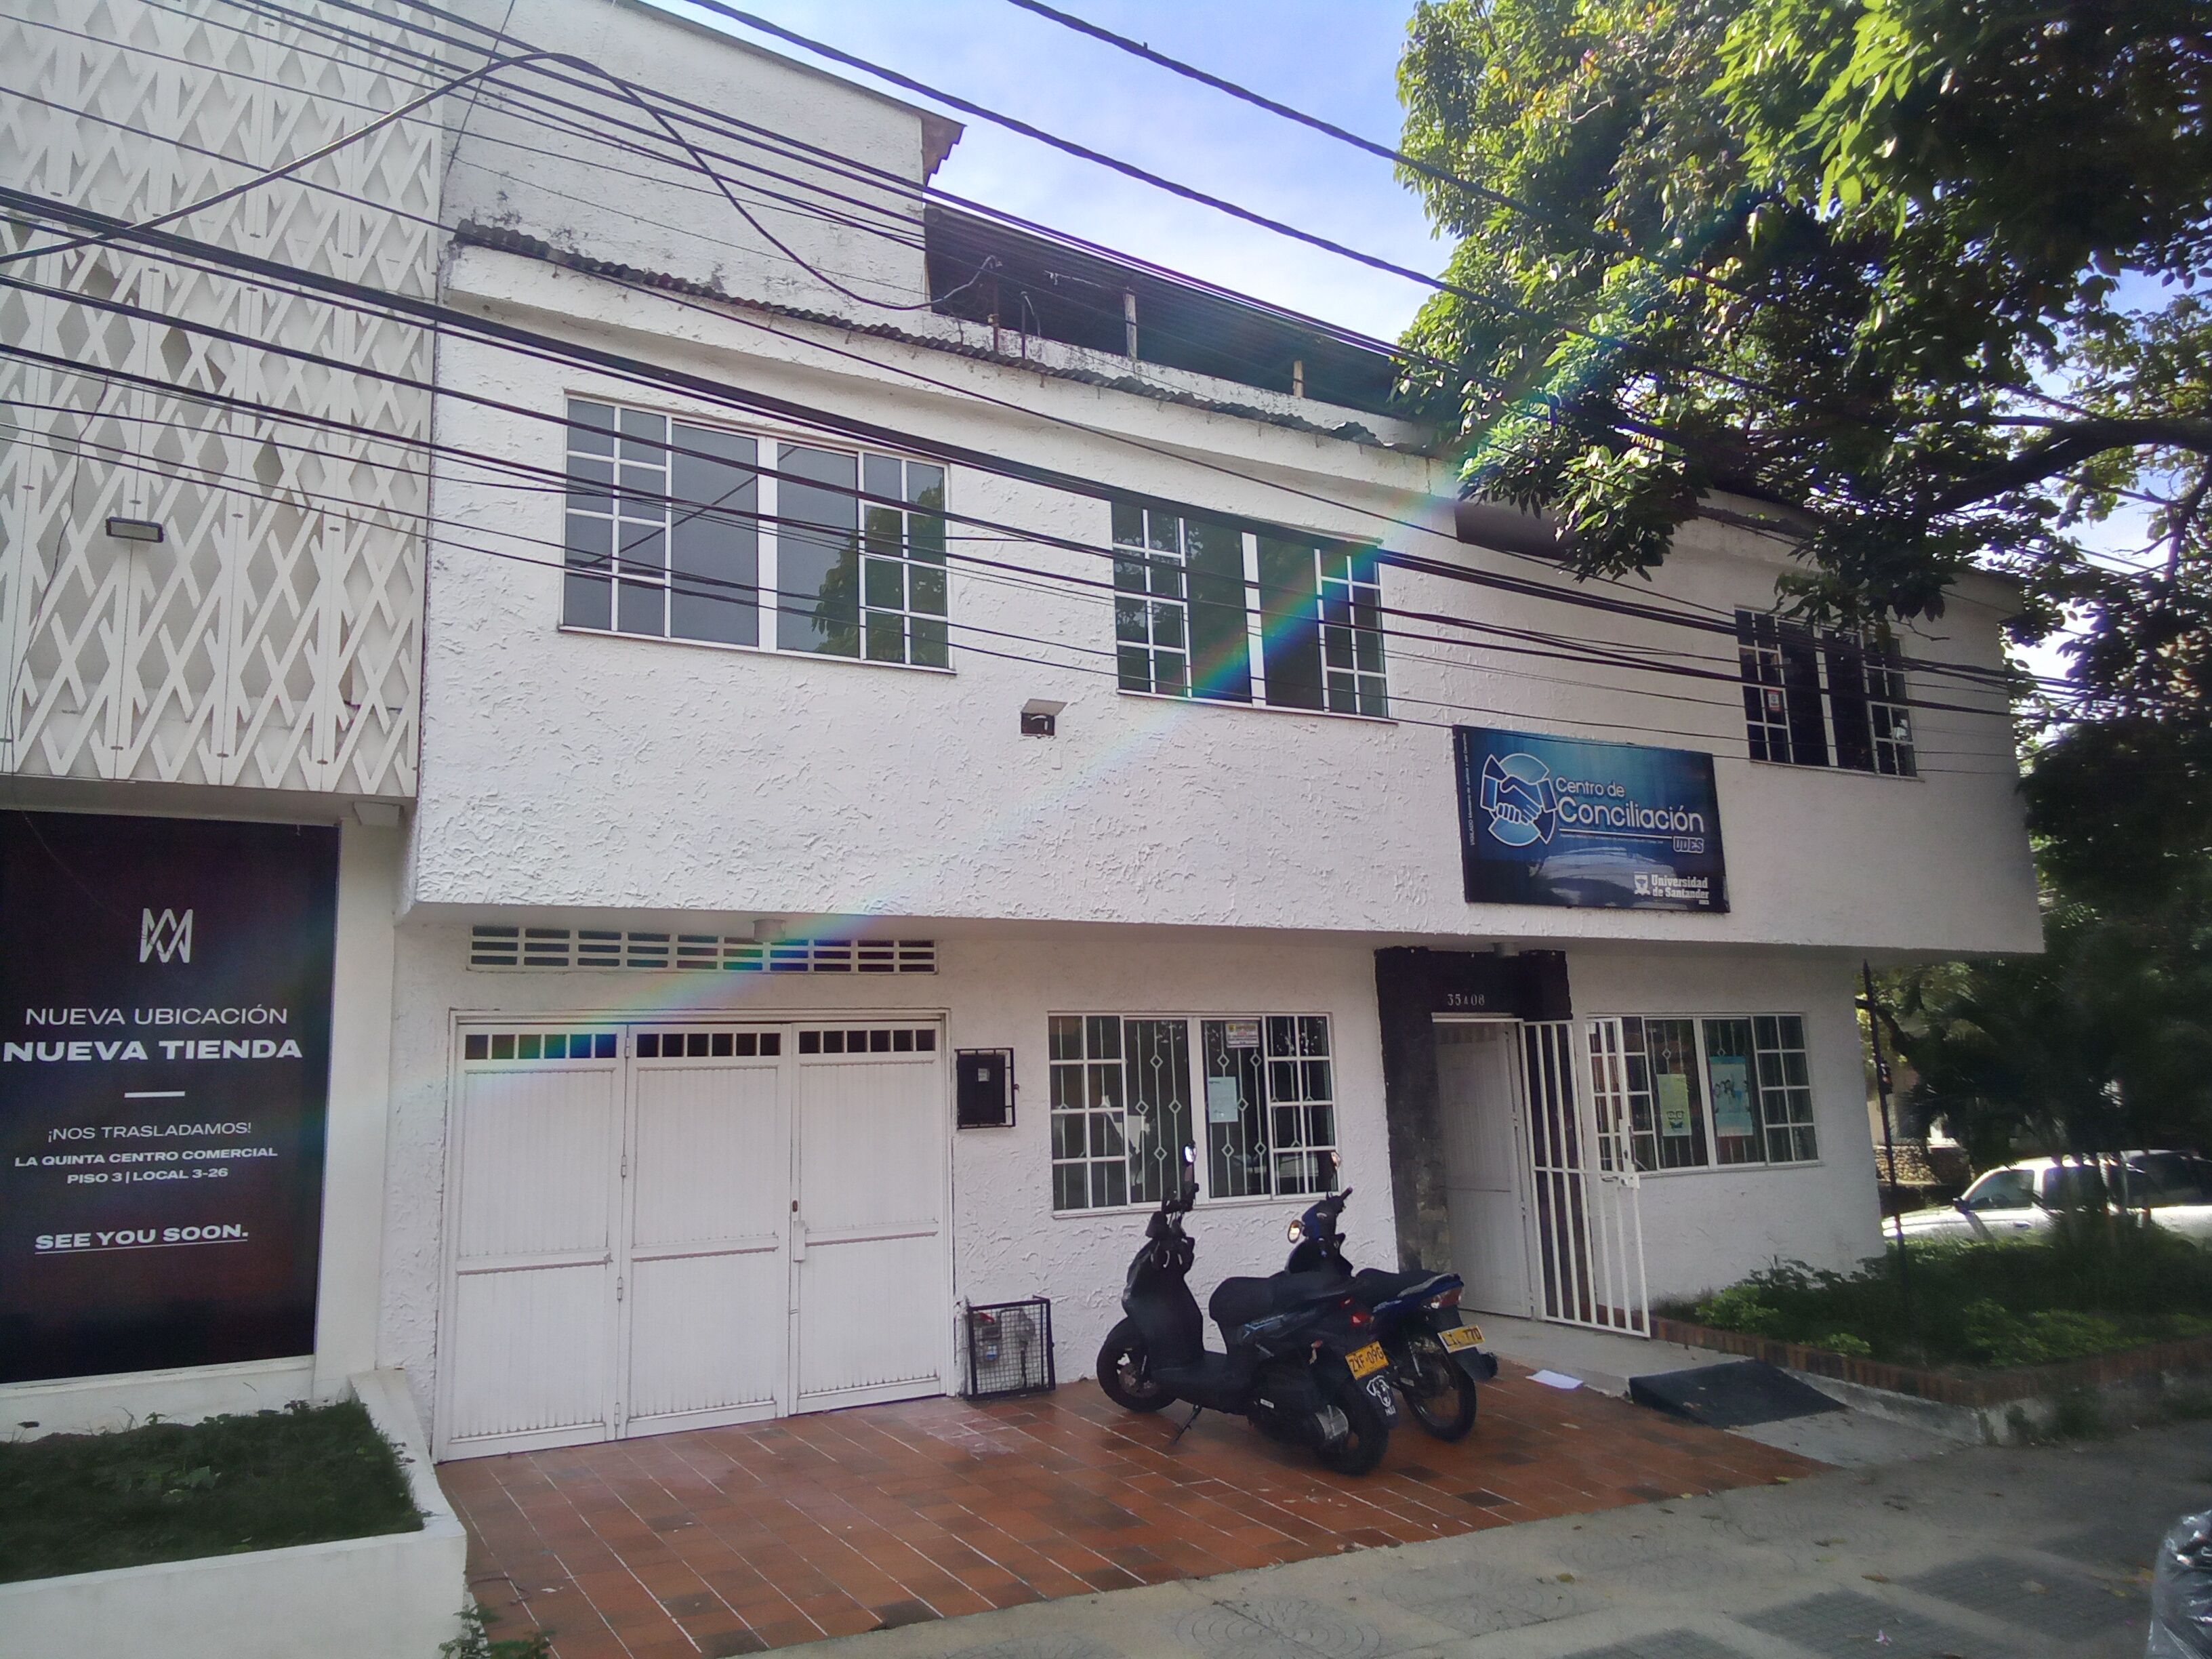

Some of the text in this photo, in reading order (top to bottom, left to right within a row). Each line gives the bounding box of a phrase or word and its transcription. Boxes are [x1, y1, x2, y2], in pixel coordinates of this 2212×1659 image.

[1555, 777, 1625, 798] Centro de
[1559, 796, 1704, 833] Conciliación
[1674, 838, 1703, 852] UDES
[1651, 874, 1708, 888] Universidad
[1652, 886, 1709, 899] de Santander
[25, 1004, 288, 1025] NUEVA UBICACIÓN
[3, 1040, 303, 1062] NUEVA TIENDA
[48, 1122, 252, 1143] ¡NOS TRASLADAMOS!
[15, 1147, 279, 1167] LA QUINTA CENTRO COMERCIAL
[67, 1173, 108, 1184] PISO
[112, 1172, 123, 1183] 3
[133, 1169, 188, 1181] LOCAL
[192, 1168, 229, 1179] 3-26
[35, 1224, 249, 1250] SEE YOU SOON.
